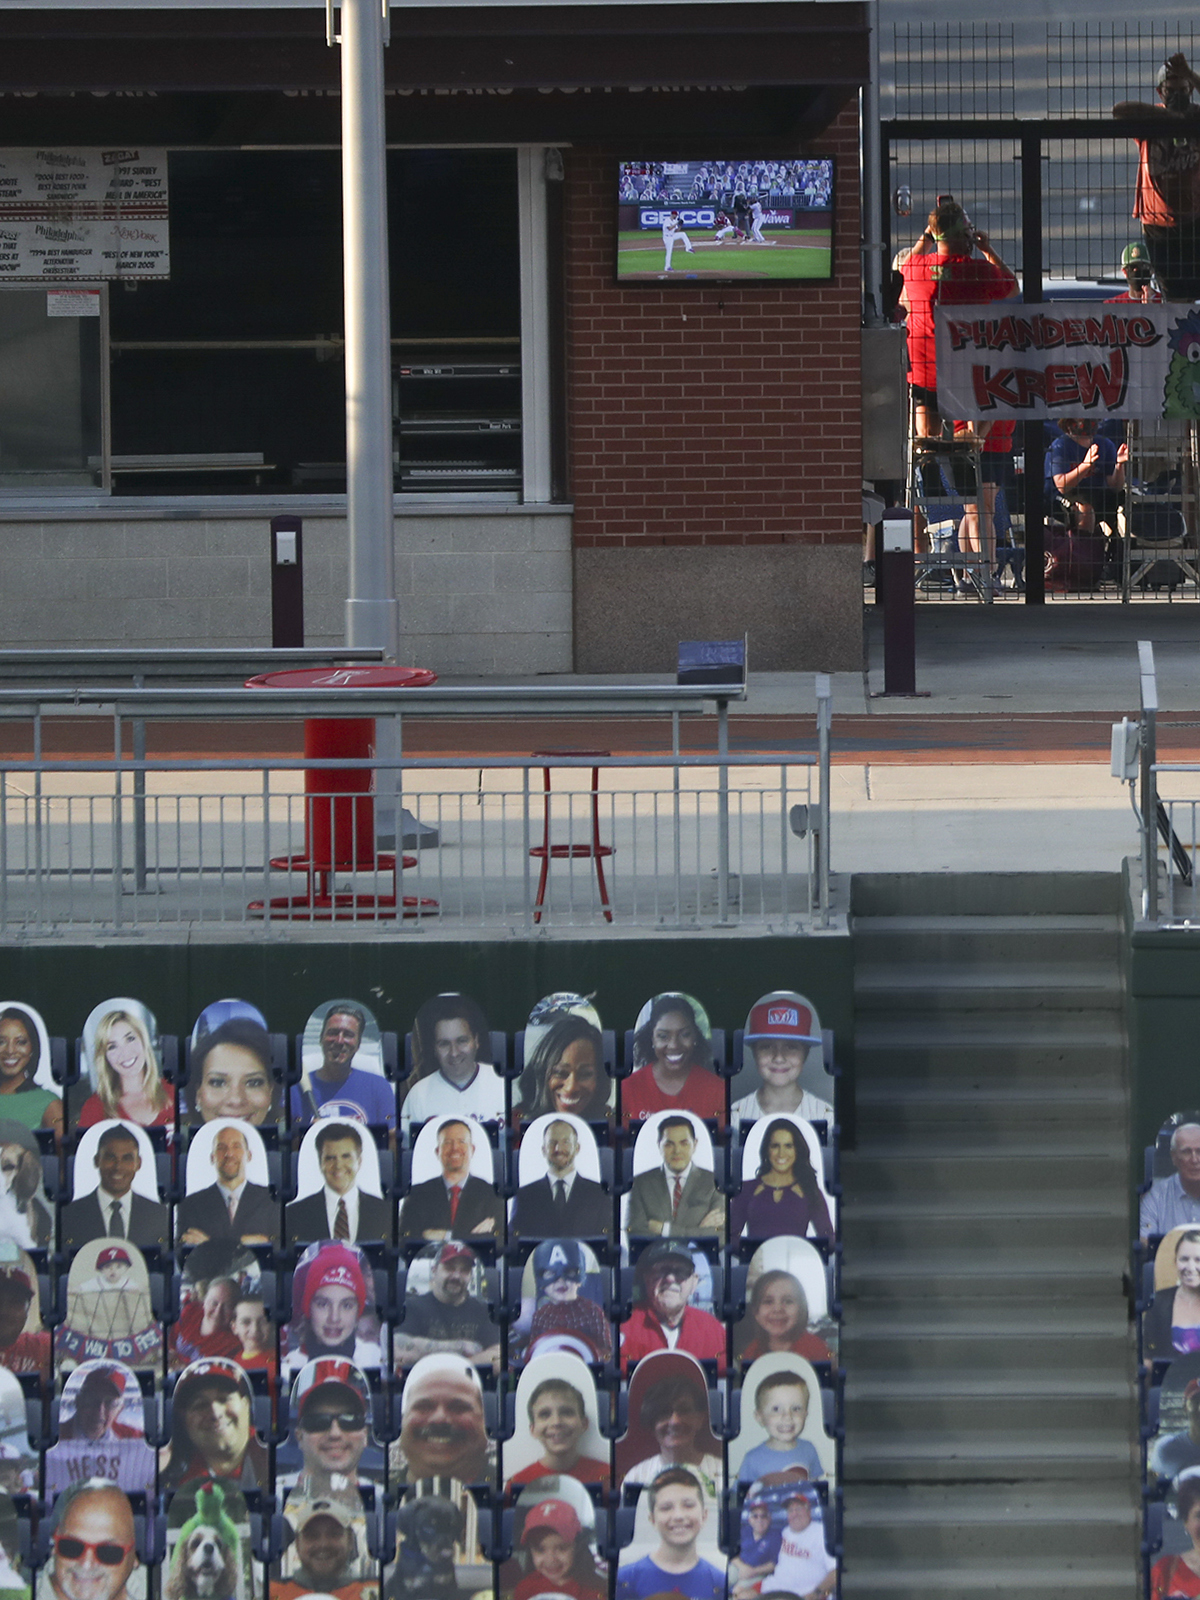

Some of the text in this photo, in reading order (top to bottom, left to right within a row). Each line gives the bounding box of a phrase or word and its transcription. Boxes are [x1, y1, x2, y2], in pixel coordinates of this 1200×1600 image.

[132, 167, 157, 175] SURVEY
[109, 179, 134, 187] AARD
[105, 191, 123, 199] MEL
[641, 210, 715, 225] GECO
[945, 313, 1163, 352] PHANDEMIC
[972, 347, 1129, 412] KREW
[548, 1244, 569, 1266] A
[66, 1454, 121, 1481] HESS
